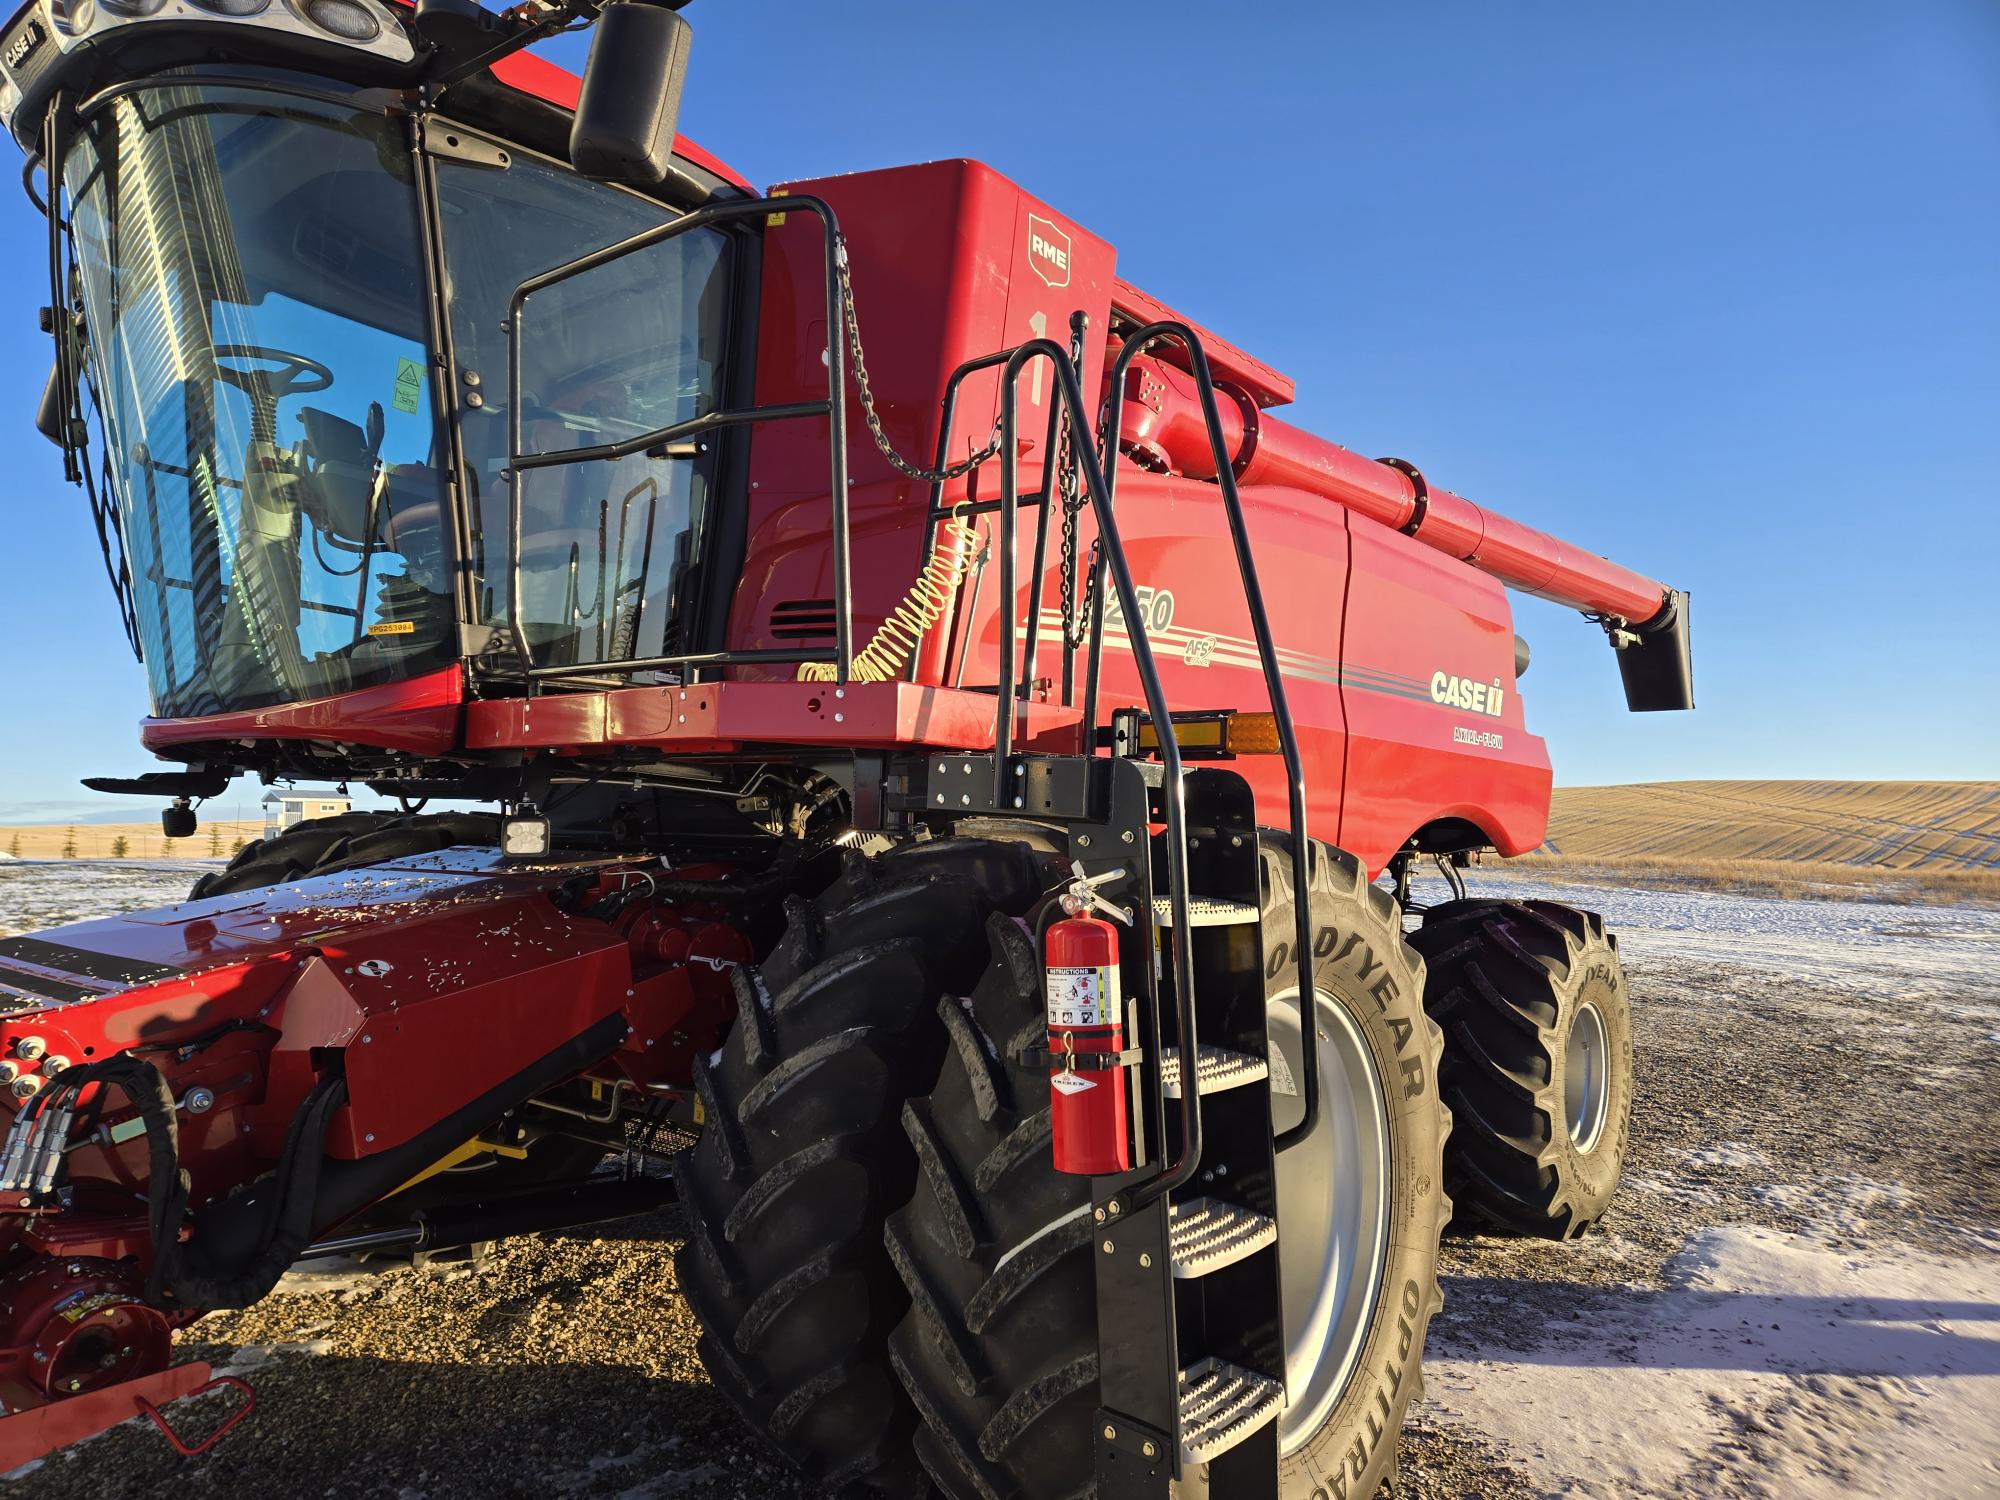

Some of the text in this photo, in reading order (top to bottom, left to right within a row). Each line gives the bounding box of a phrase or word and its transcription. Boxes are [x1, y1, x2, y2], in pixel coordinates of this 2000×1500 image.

[5, 35, 30, 68] CASE
[1032, 233, 1067, 271] RME
[1083, 584, 1174, 633] 250
[1185, 639, 1209, 657] AFS
[1431, 671, 1486, 713] CASE
[1454, 727, 1503, 749] AXIAL-FLOW
[1266, 926, 1426, 1101] ODYEAR
